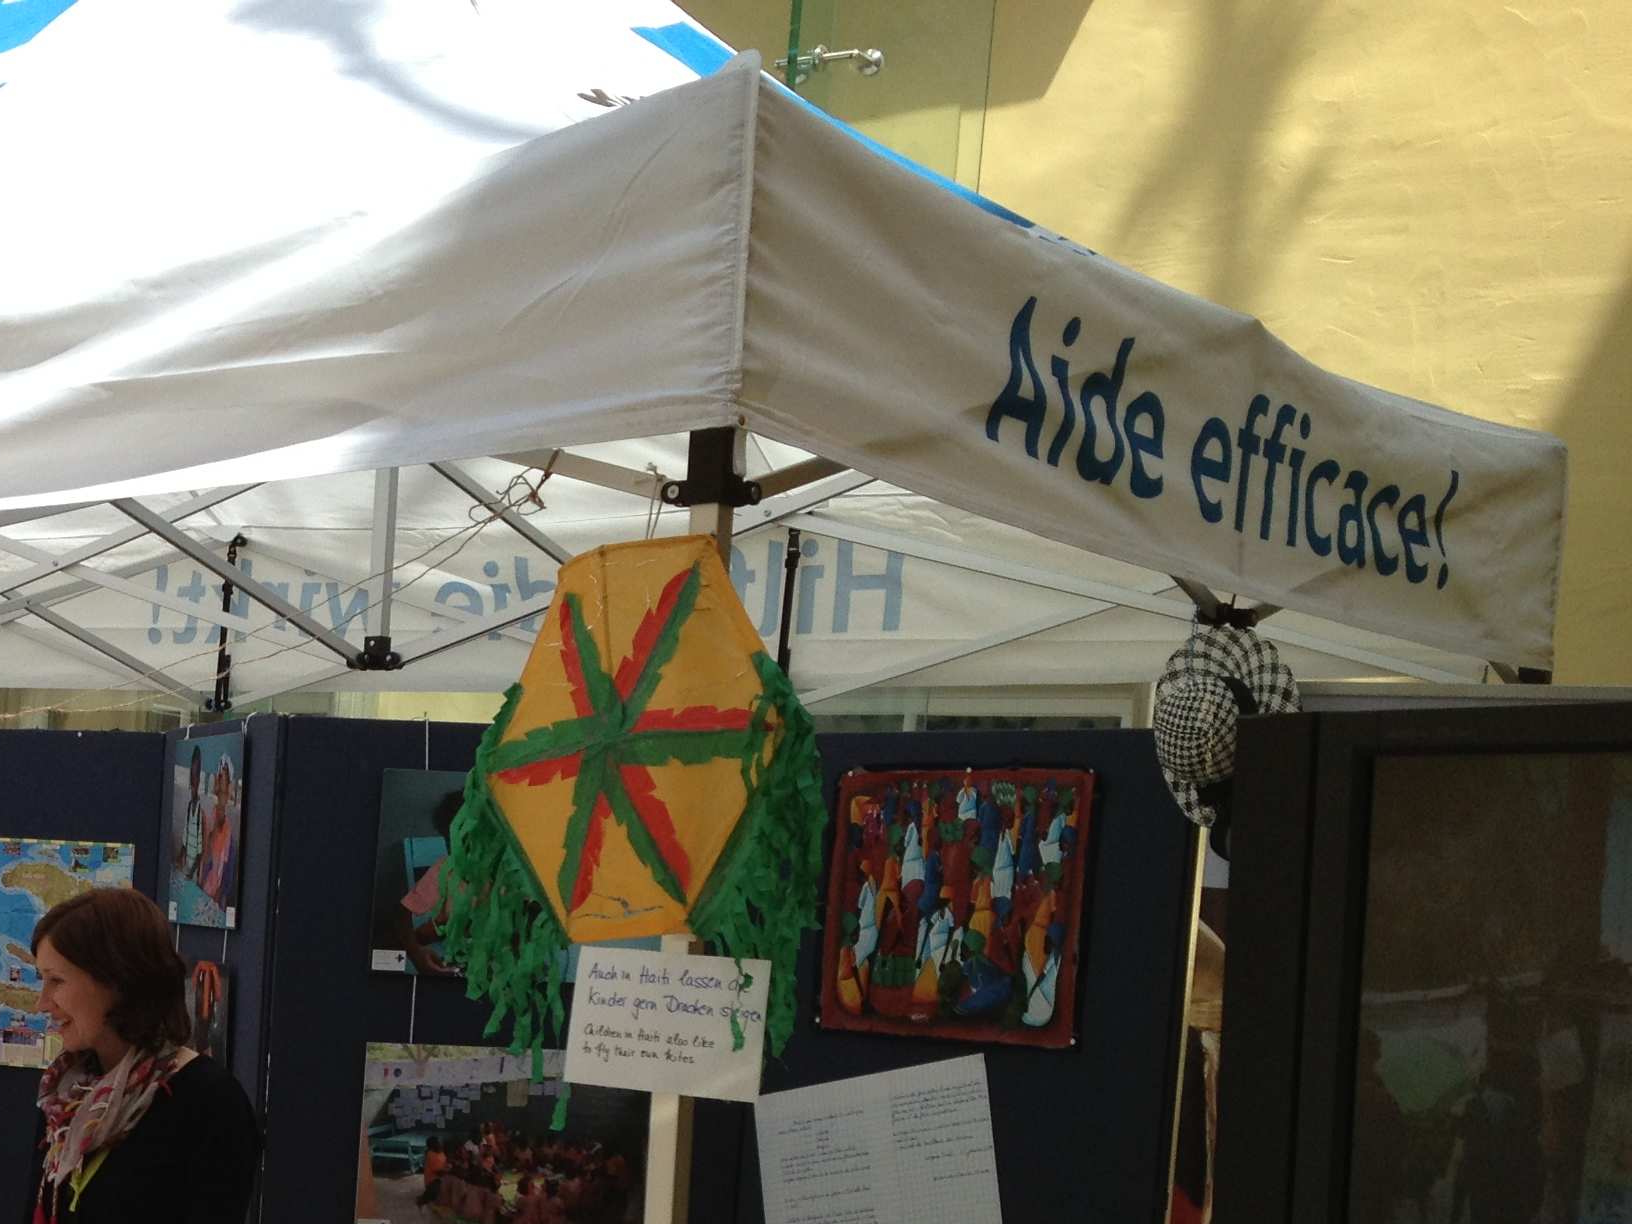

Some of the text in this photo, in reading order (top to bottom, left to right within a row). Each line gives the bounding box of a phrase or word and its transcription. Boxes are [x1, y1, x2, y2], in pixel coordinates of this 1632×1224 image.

[986, 296, 1459, 590] Aide efficace!
[639, 964, 670, 984] Haiti
